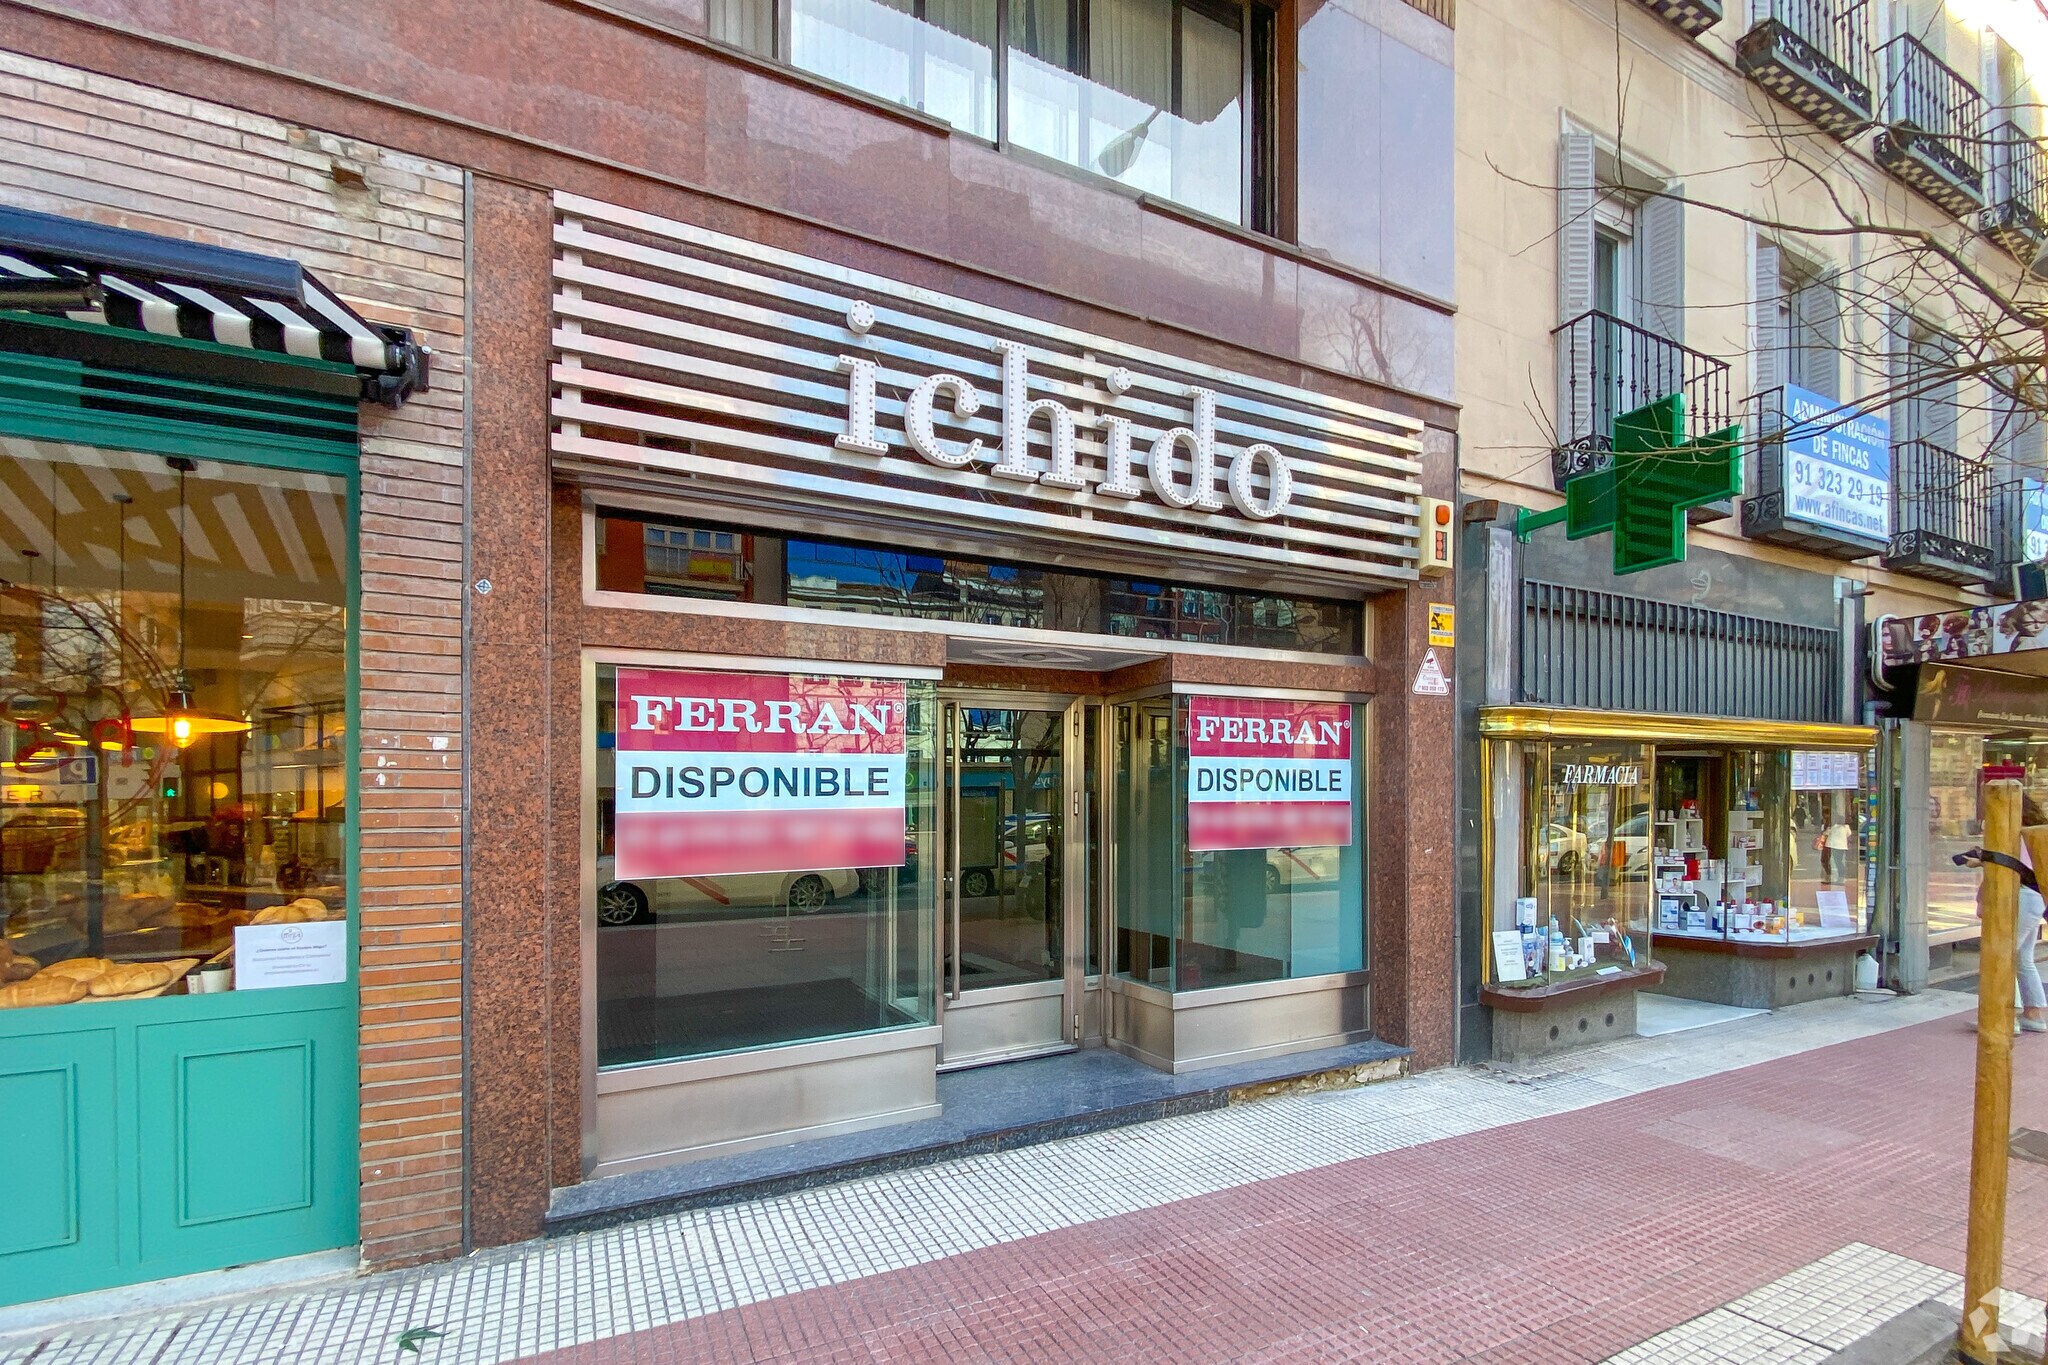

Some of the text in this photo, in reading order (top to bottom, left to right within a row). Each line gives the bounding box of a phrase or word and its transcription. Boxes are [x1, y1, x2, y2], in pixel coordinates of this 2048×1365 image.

[834, 299, 1292, 521] ichido
[1813, 435, 1869, 471] DE FINCAS
[1795, 460, 1883, 507] 91 323 29 19
[1795, 494, 1883, 532] www.afincas.net
[631, 765, 890, 799] DISPONIBLE
[1197, 767, 1342, 793] DISPONIBLE
[1562, 764, 1639, 785] FARMACIA
